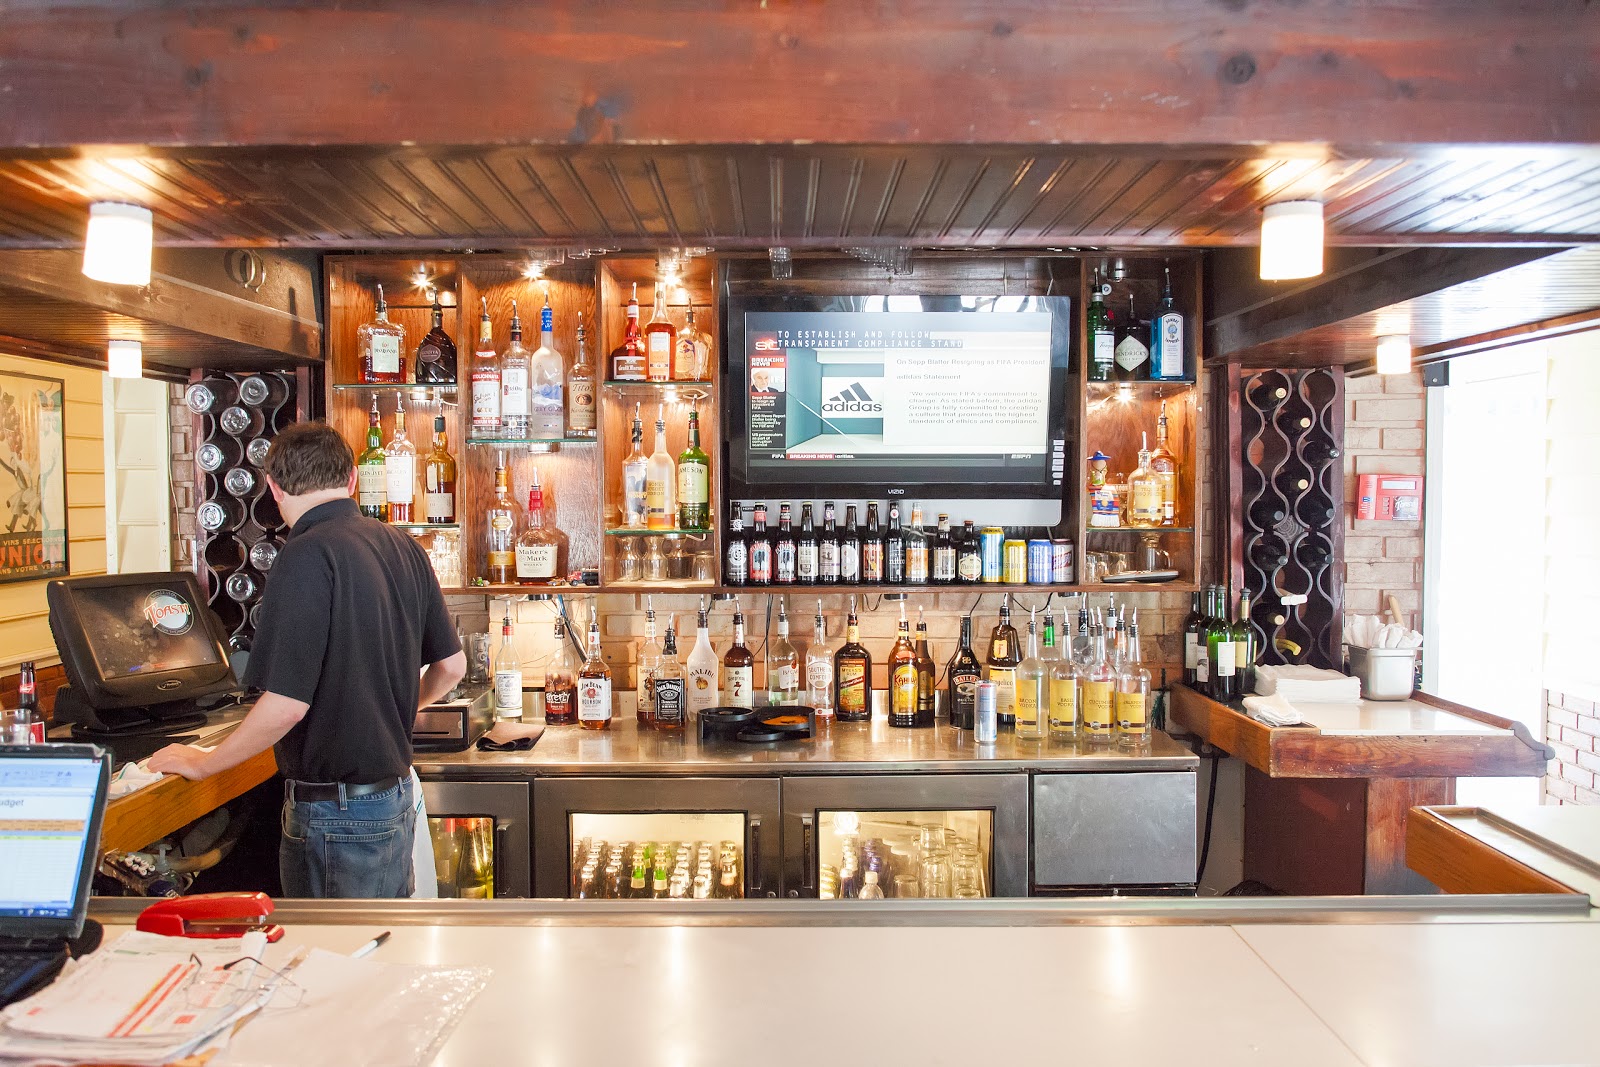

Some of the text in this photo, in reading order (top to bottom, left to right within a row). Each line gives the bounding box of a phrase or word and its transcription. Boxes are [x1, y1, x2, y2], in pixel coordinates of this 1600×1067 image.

[778, 340, 848, 348] TRANSPARENT
[858, 340, 922, 348] COMPLIANCE
[572, 383, 594, 392] Tito's
[822, 402, 882, 412] adidas
[690, 668, 715, 678] MALIBU
[589, 682, 602, 690] BEAM
[0, 800, 24, 808] udget
